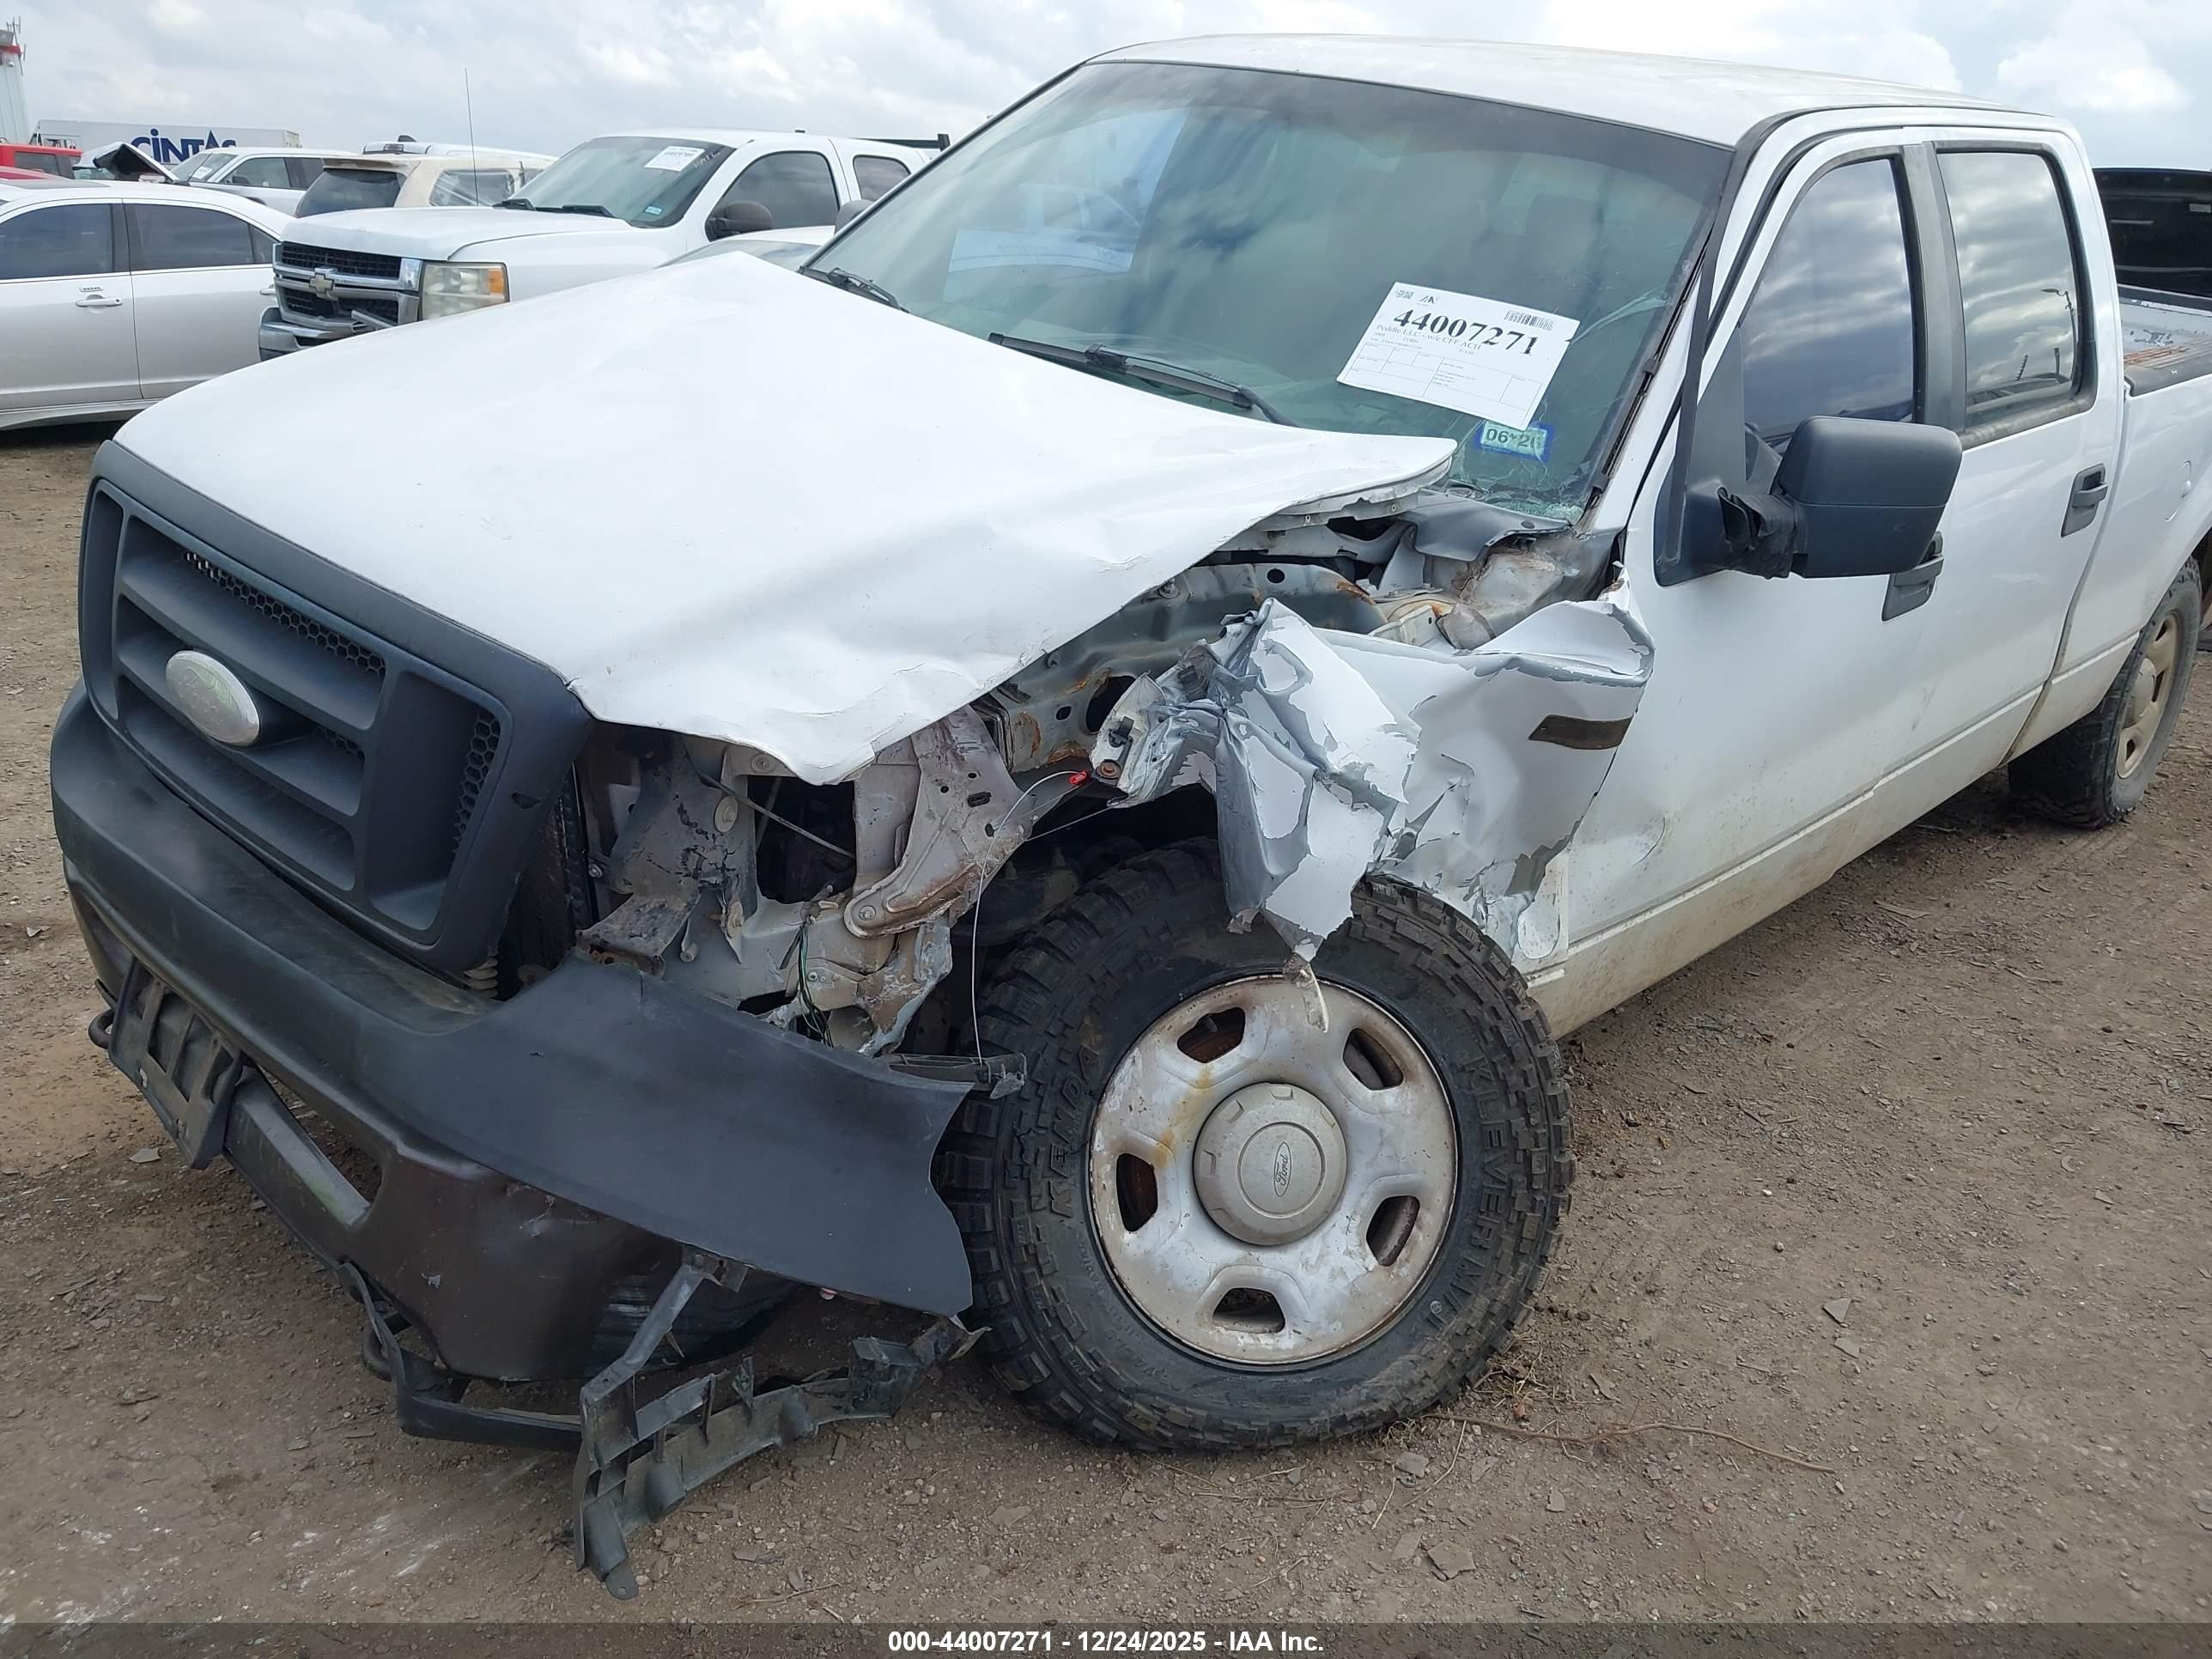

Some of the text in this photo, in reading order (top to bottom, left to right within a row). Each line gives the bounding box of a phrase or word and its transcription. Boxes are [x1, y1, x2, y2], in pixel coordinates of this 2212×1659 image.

[1394, 309, 1540, 356] 44007271
[1486, 428, 1510, 443] 06
[1048, 1044, 1101, 1218] KENDA
[1462, 1056, 1508, 1249] KLEVER
[1276, 1153, 1289, 1186] Ford
